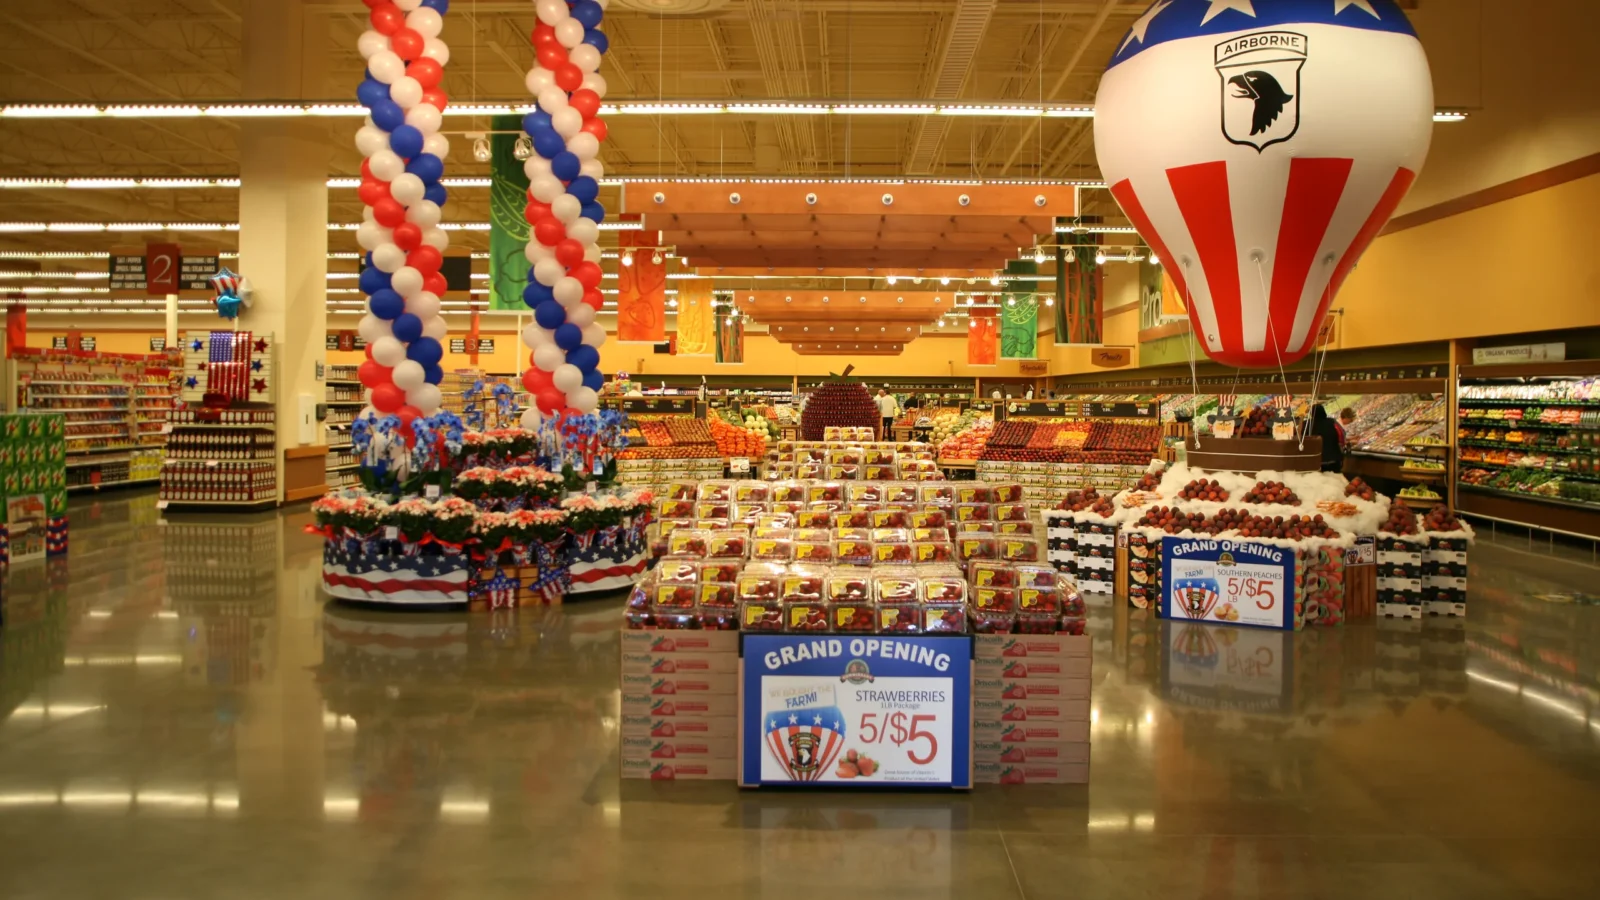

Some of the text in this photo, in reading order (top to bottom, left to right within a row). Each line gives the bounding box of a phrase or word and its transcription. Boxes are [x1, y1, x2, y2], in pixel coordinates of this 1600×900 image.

[1224, 35, 1299, 55] AIRBORNE
[152, 254, 172, 285] 2
[468, 338, 476, 350] 3
[1172, 540, 1283, 563] GRAND OPENING
[1217, 568, 1253, 578] SOUTHERN
[1253, 570, 1282, 580] PEACHES
[1227, 577, 1275, 611] 5/$5
[1227, 595, 1238, 603] LB
[764, 638, 951, 672] GRAND OPENING
[785, 691, 817, 709] FARM!
[855, 690, 945, 703] STRAWBERRIES
[893, 702, 920, 710] Package
[858, 710, 938, 765] 5/$5
